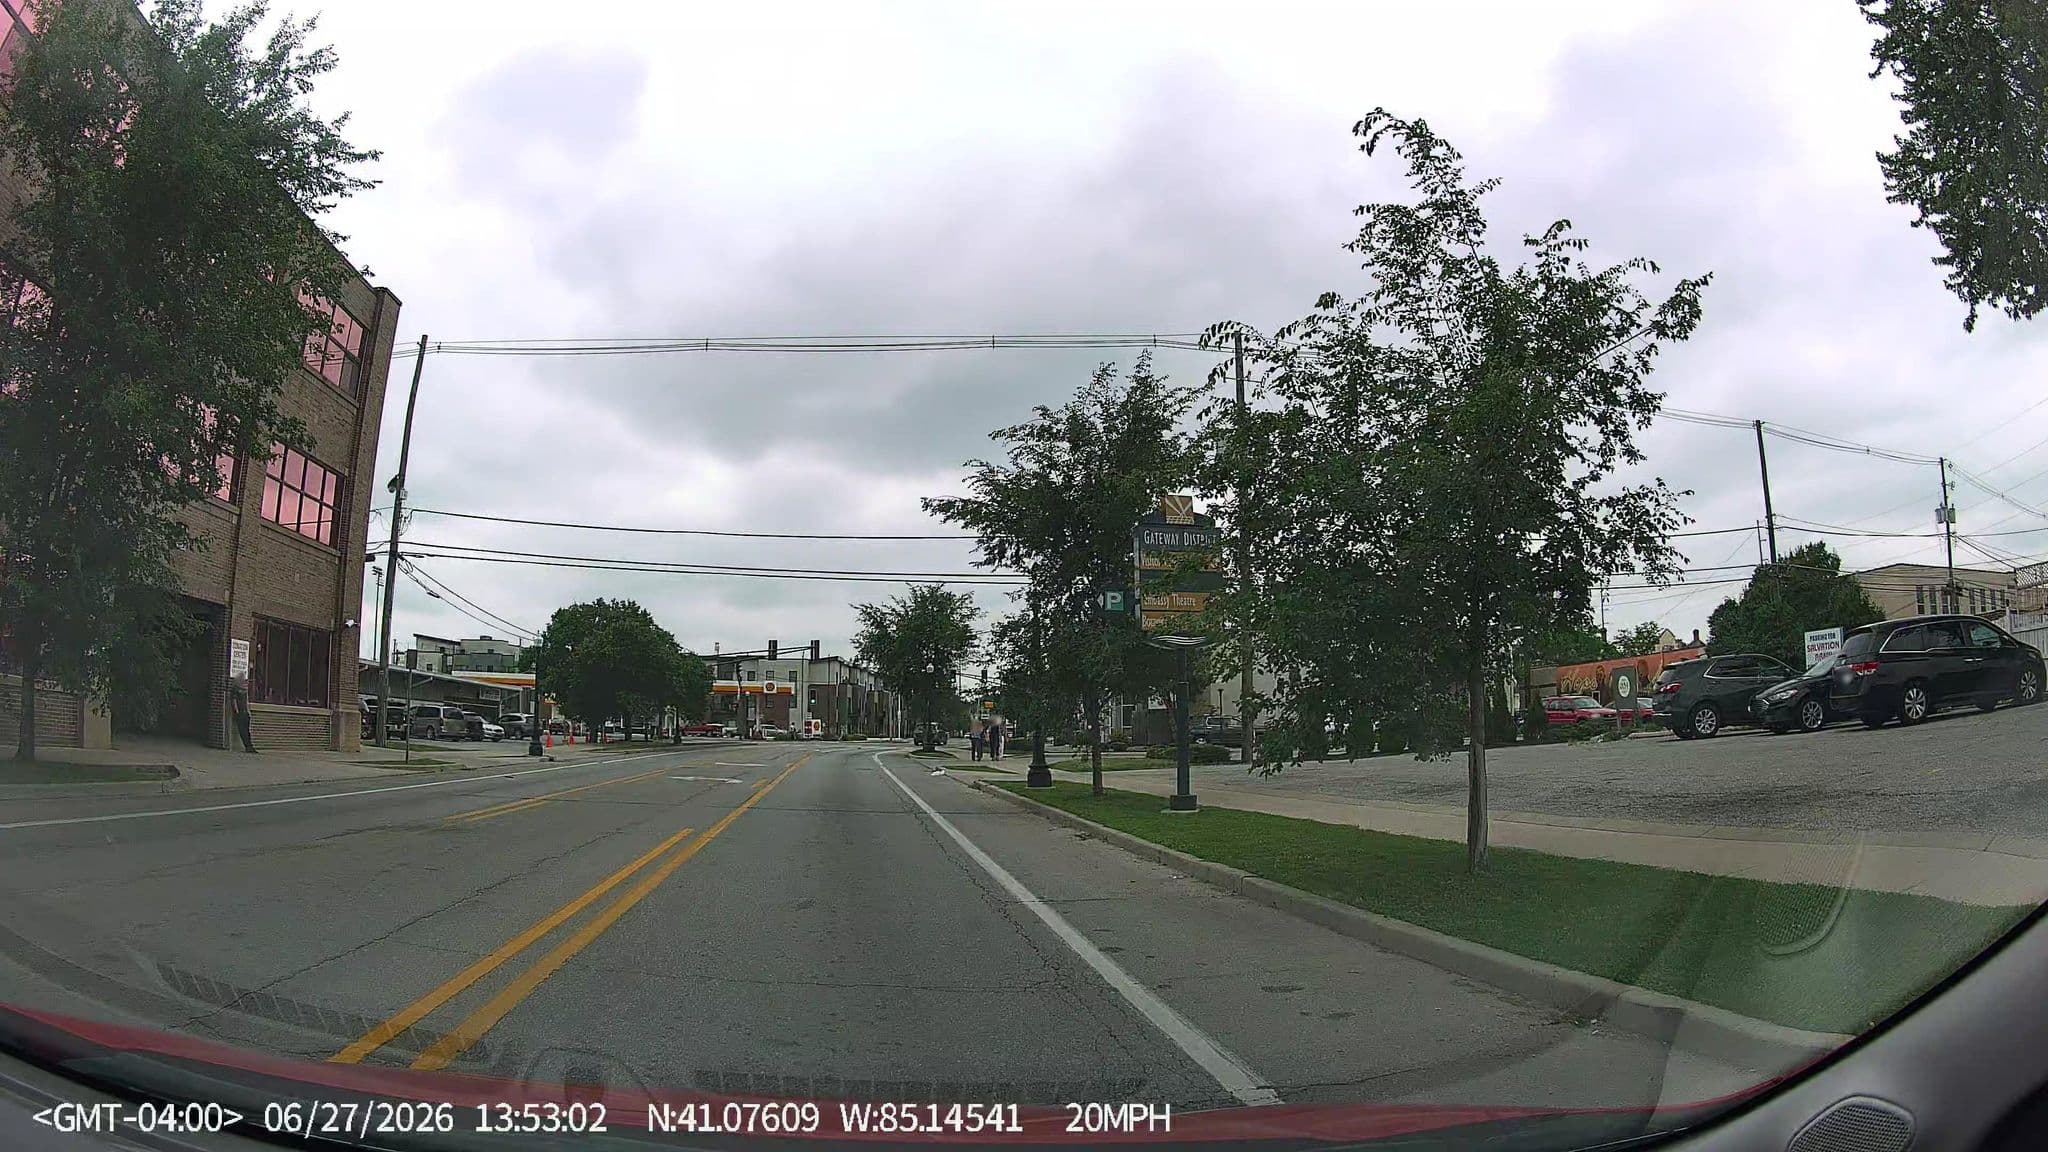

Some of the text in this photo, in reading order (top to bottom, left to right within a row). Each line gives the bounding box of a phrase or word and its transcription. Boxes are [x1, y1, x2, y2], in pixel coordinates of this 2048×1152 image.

[1143, 529, 1179, 545] GATEWAY
[1106, 592, 1122, 609] P
[1171, 593, 1196, 607] Theatre
[1807, 640, 1840, 653] SALVATION
